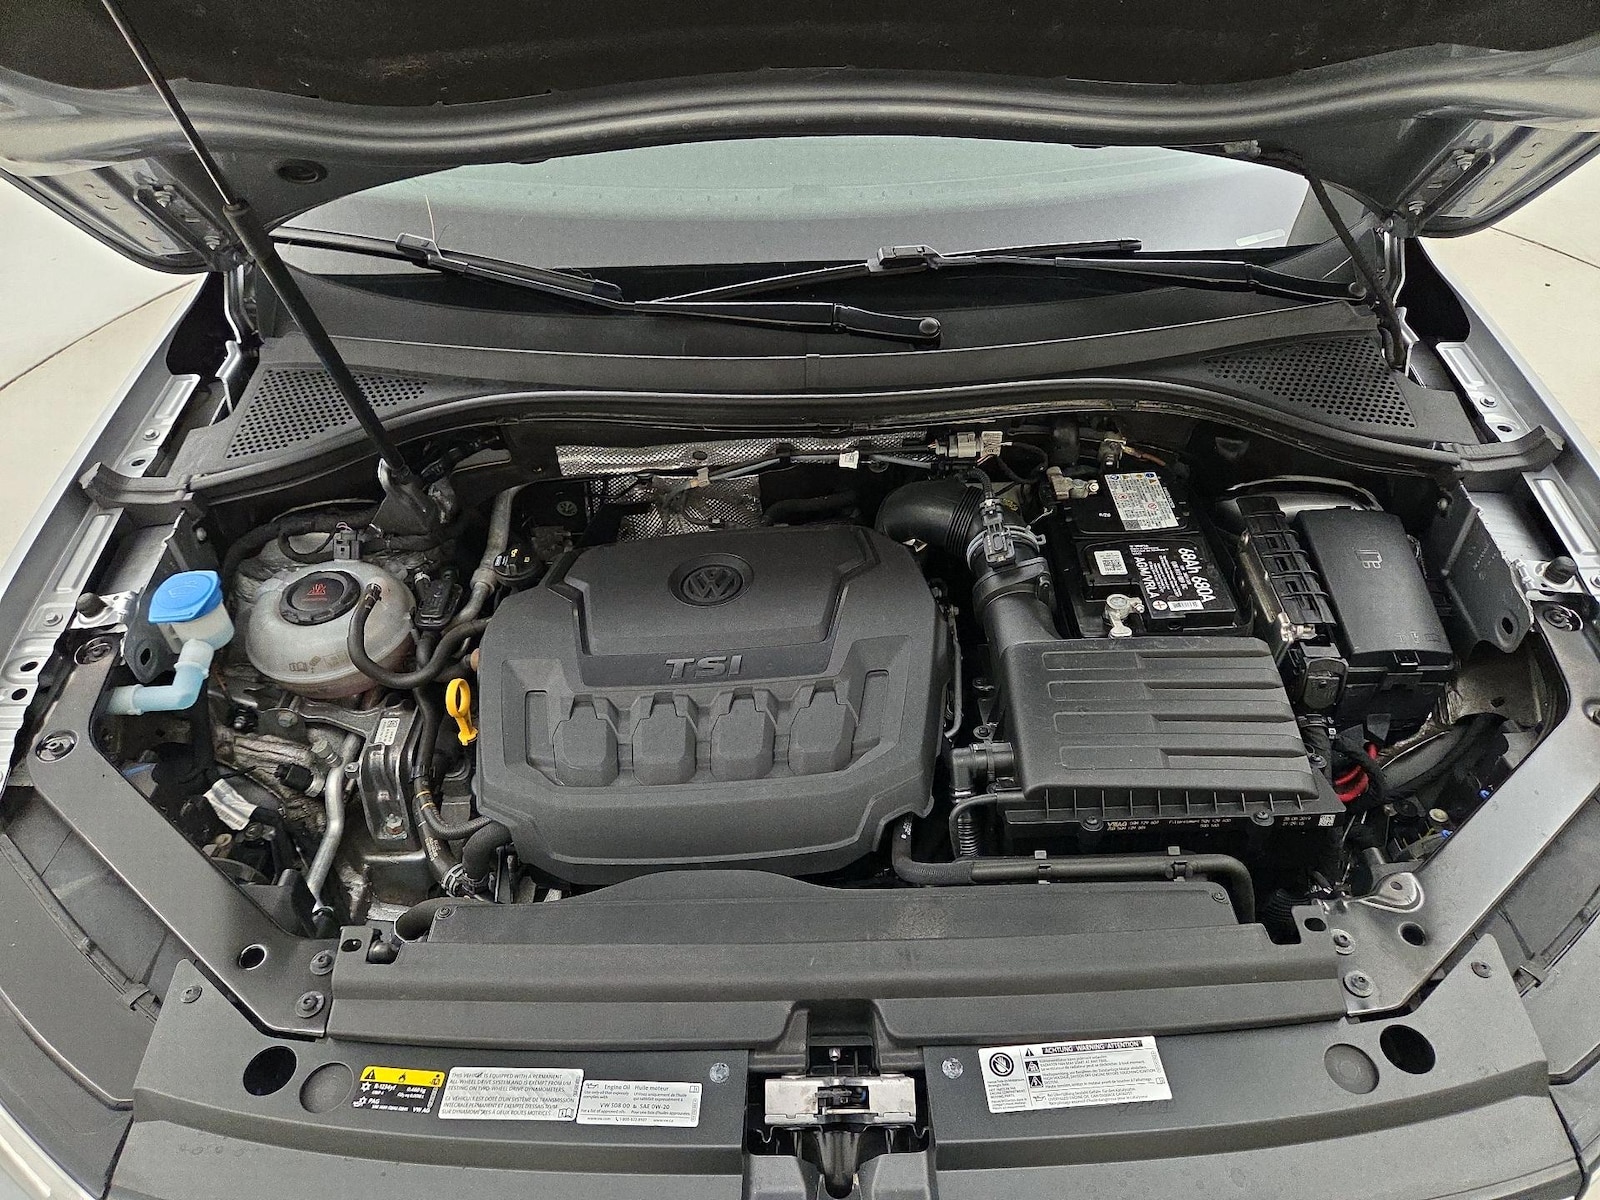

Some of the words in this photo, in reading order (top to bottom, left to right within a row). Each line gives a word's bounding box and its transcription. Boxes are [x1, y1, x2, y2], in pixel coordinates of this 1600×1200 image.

[1134, 557, 1160, 599] AGM/VRLA
[1178, 548, 1202, 575] 68Ah
[1191, 576, 1216, 603] 680A
[666, 655, 743, 680] TSI
[1044, 1045, 1073, 1054] ACHTUNG
[1075, 1043, 1104, 1051] WARNING
[1107, 1040, 1139, 1049] ATTENTION
